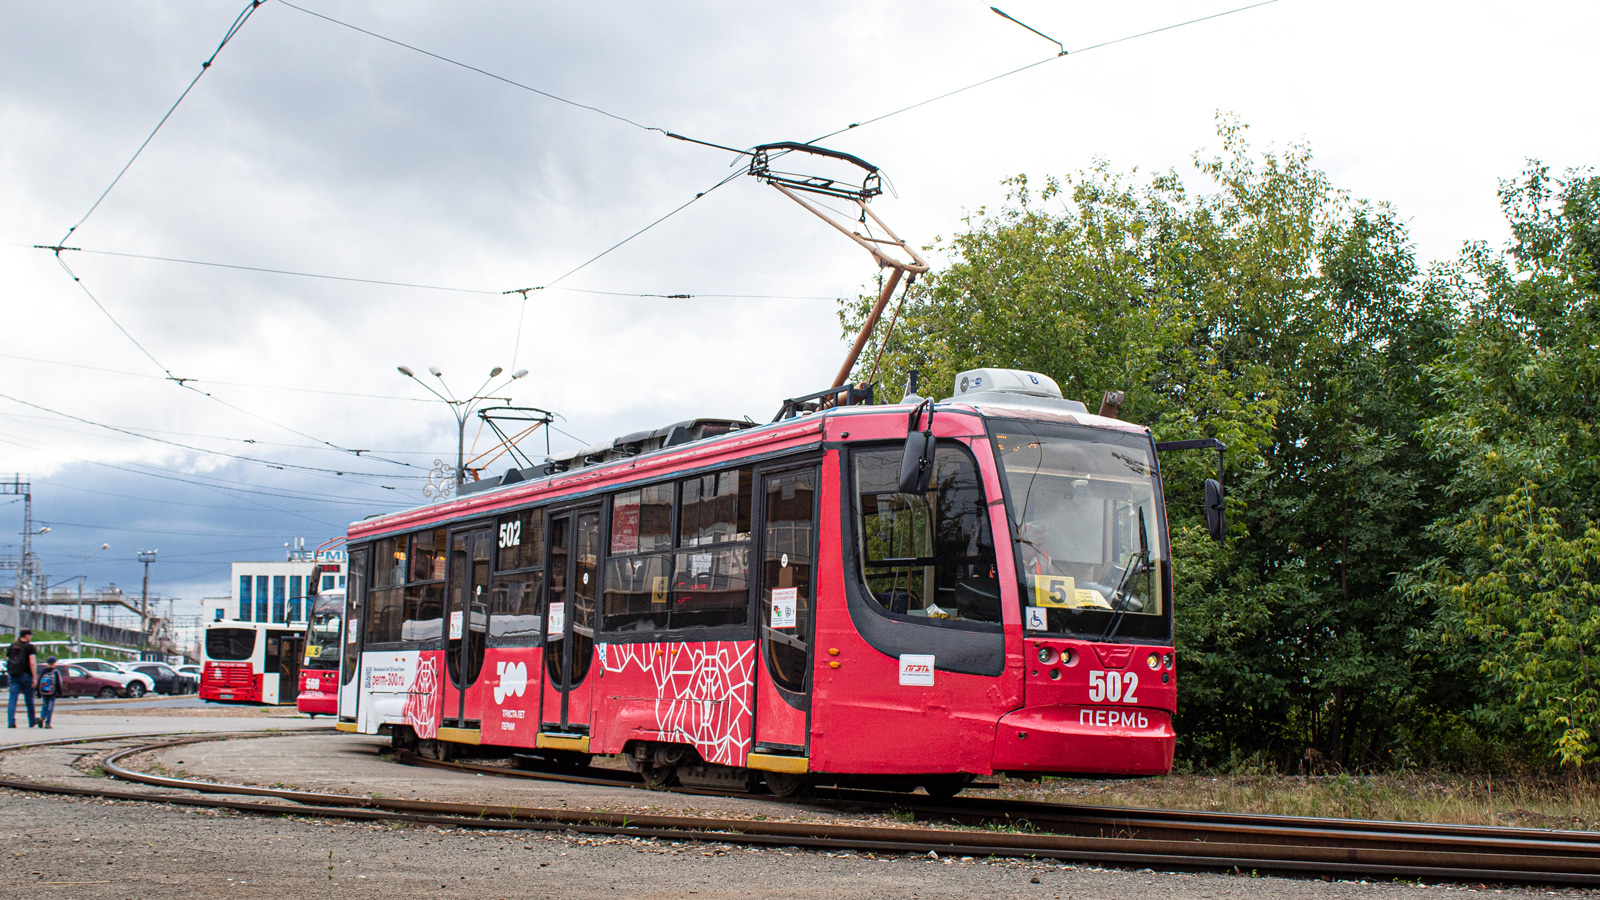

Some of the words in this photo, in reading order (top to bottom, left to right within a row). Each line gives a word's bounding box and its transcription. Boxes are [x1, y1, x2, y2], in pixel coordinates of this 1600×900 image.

[499, 520, 521, 548] 502
[1049, 579, 1067, 604] 5
[1088, 670, 1139, 703] 502
[1079, 708, 1149, 729] ПЕРМЬ
